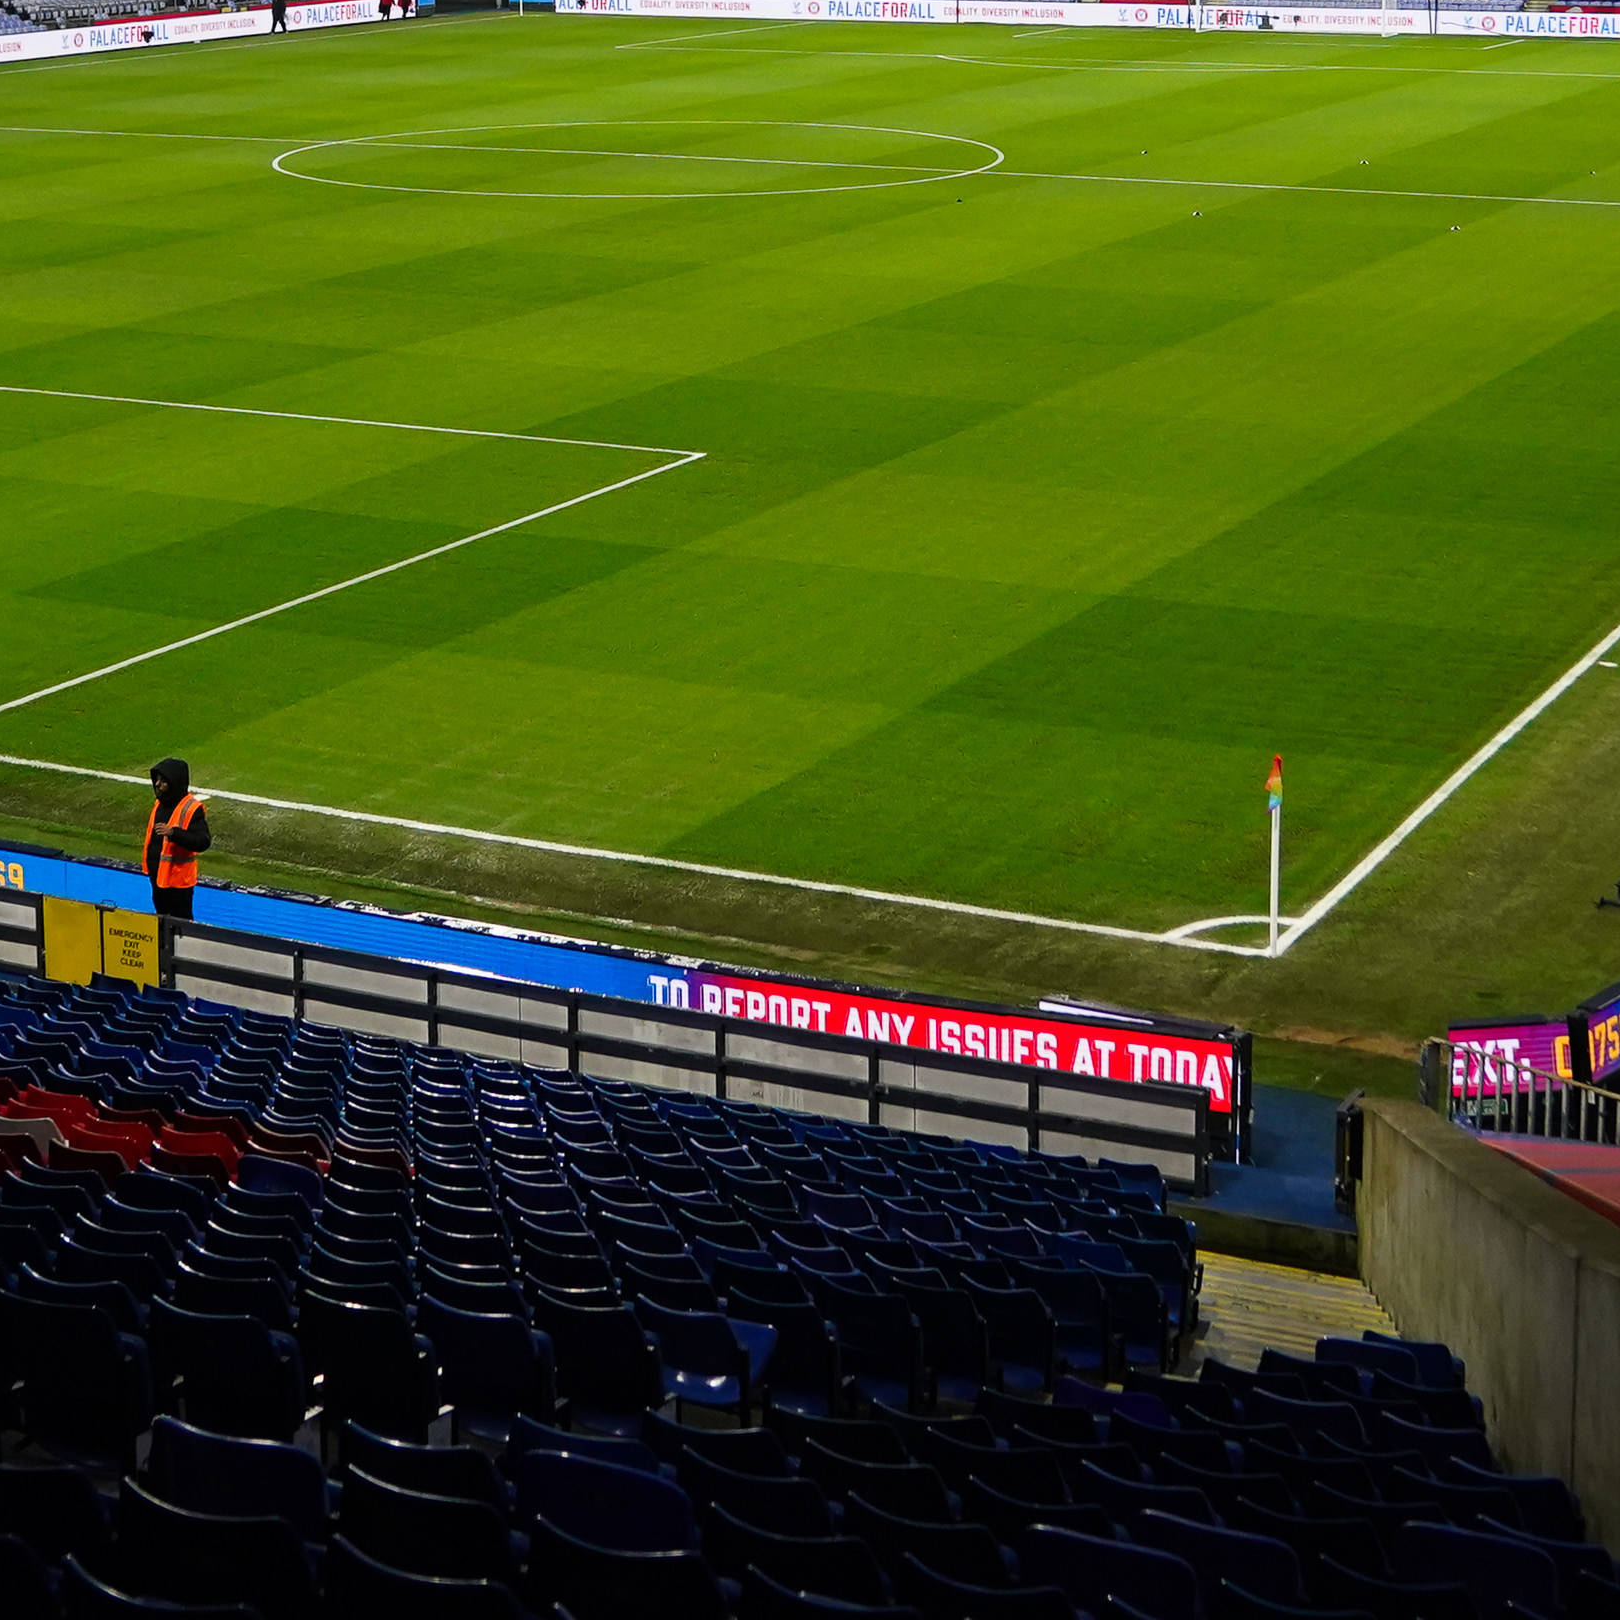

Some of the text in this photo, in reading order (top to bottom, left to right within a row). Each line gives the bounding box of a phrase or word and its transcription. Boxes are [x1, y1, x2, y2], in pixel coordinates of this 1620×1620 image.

[109, 927, 153, 943] EMERGENCY
[124, 939, 140, 949] EXIT
[122, 949, 142, 959] KEEP
[120, 958, 145, 969] CLEAR
[702, 984, 831, 1031] REPORT
[844, 1006, 915, 1047] ANY
[1071, 1037, 1115, 1079] AT
